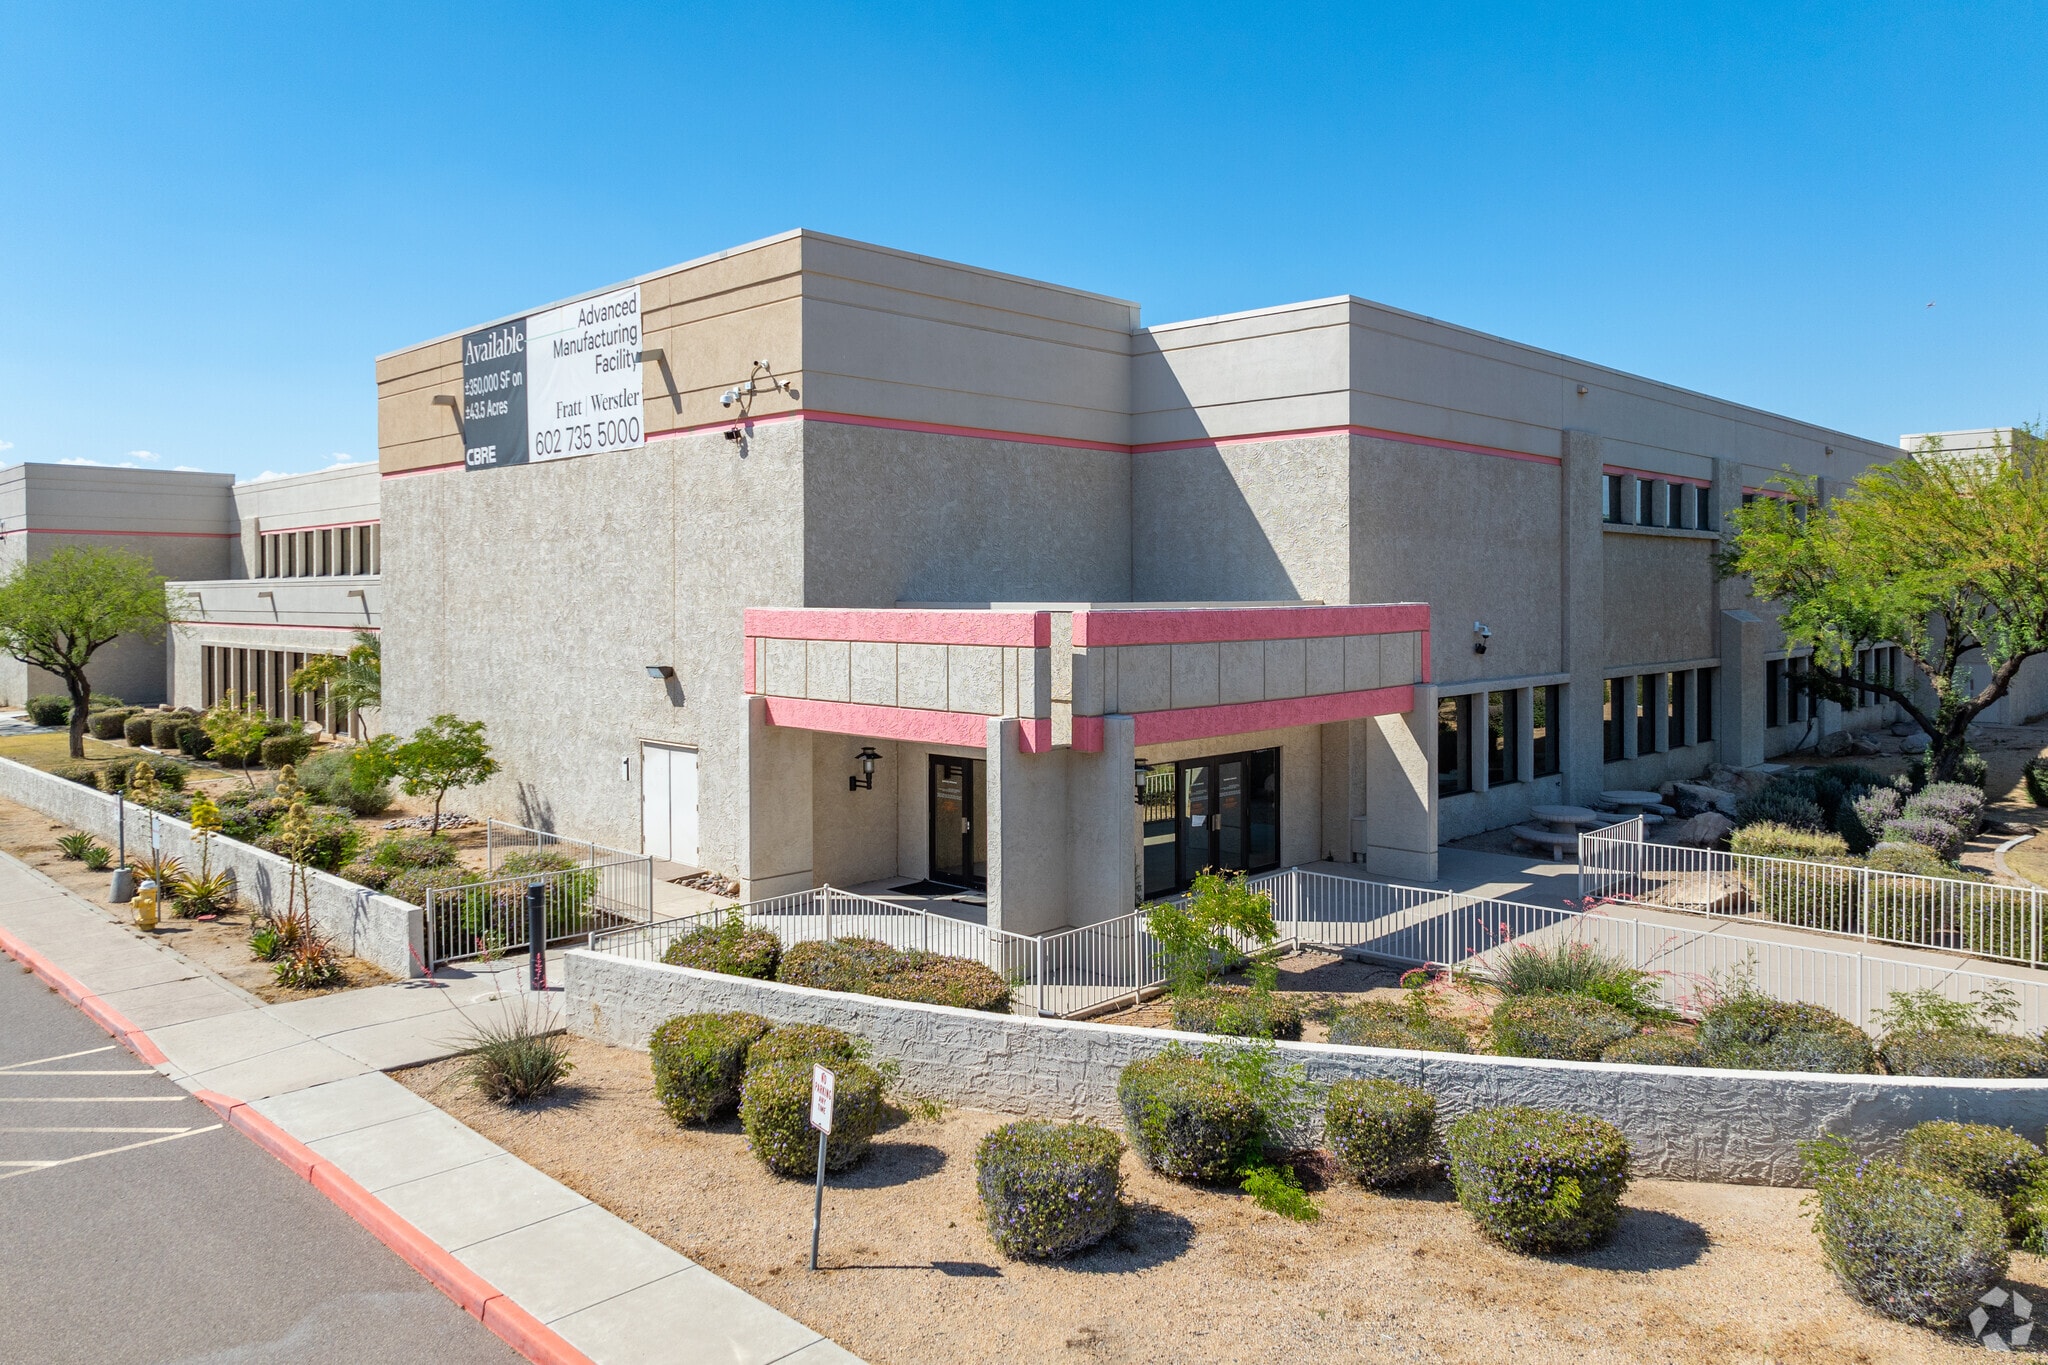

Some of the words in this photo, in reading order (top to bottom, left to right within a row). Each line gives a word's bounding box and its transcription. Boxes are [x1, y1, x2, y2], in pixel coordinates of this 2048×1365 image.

[578, 292, 637, 328] Advanced
[464, 326, 524, 366] Available
[553, 324, 638, 359] Manufacturing
[595, 348, 637, 374] Facility
[465, 373, 499, 396] ±350,000
[500, 370, 511, 389] SF
[512, 371, 523, 386] on
[487, 399, 508, 418] Acres
[556, 401, 582, 419] Fratt
[591, 388, 640, 413] Werstler
[536, 429, 562, 456] 602
[566, 424, 592, 450] 735
[597, 416, 640, 448] 5000
[466, 445, 497, 466] CBRE
[623, 757, 630, 781] 1
[815, 1081, 832, 1101] PARKING
